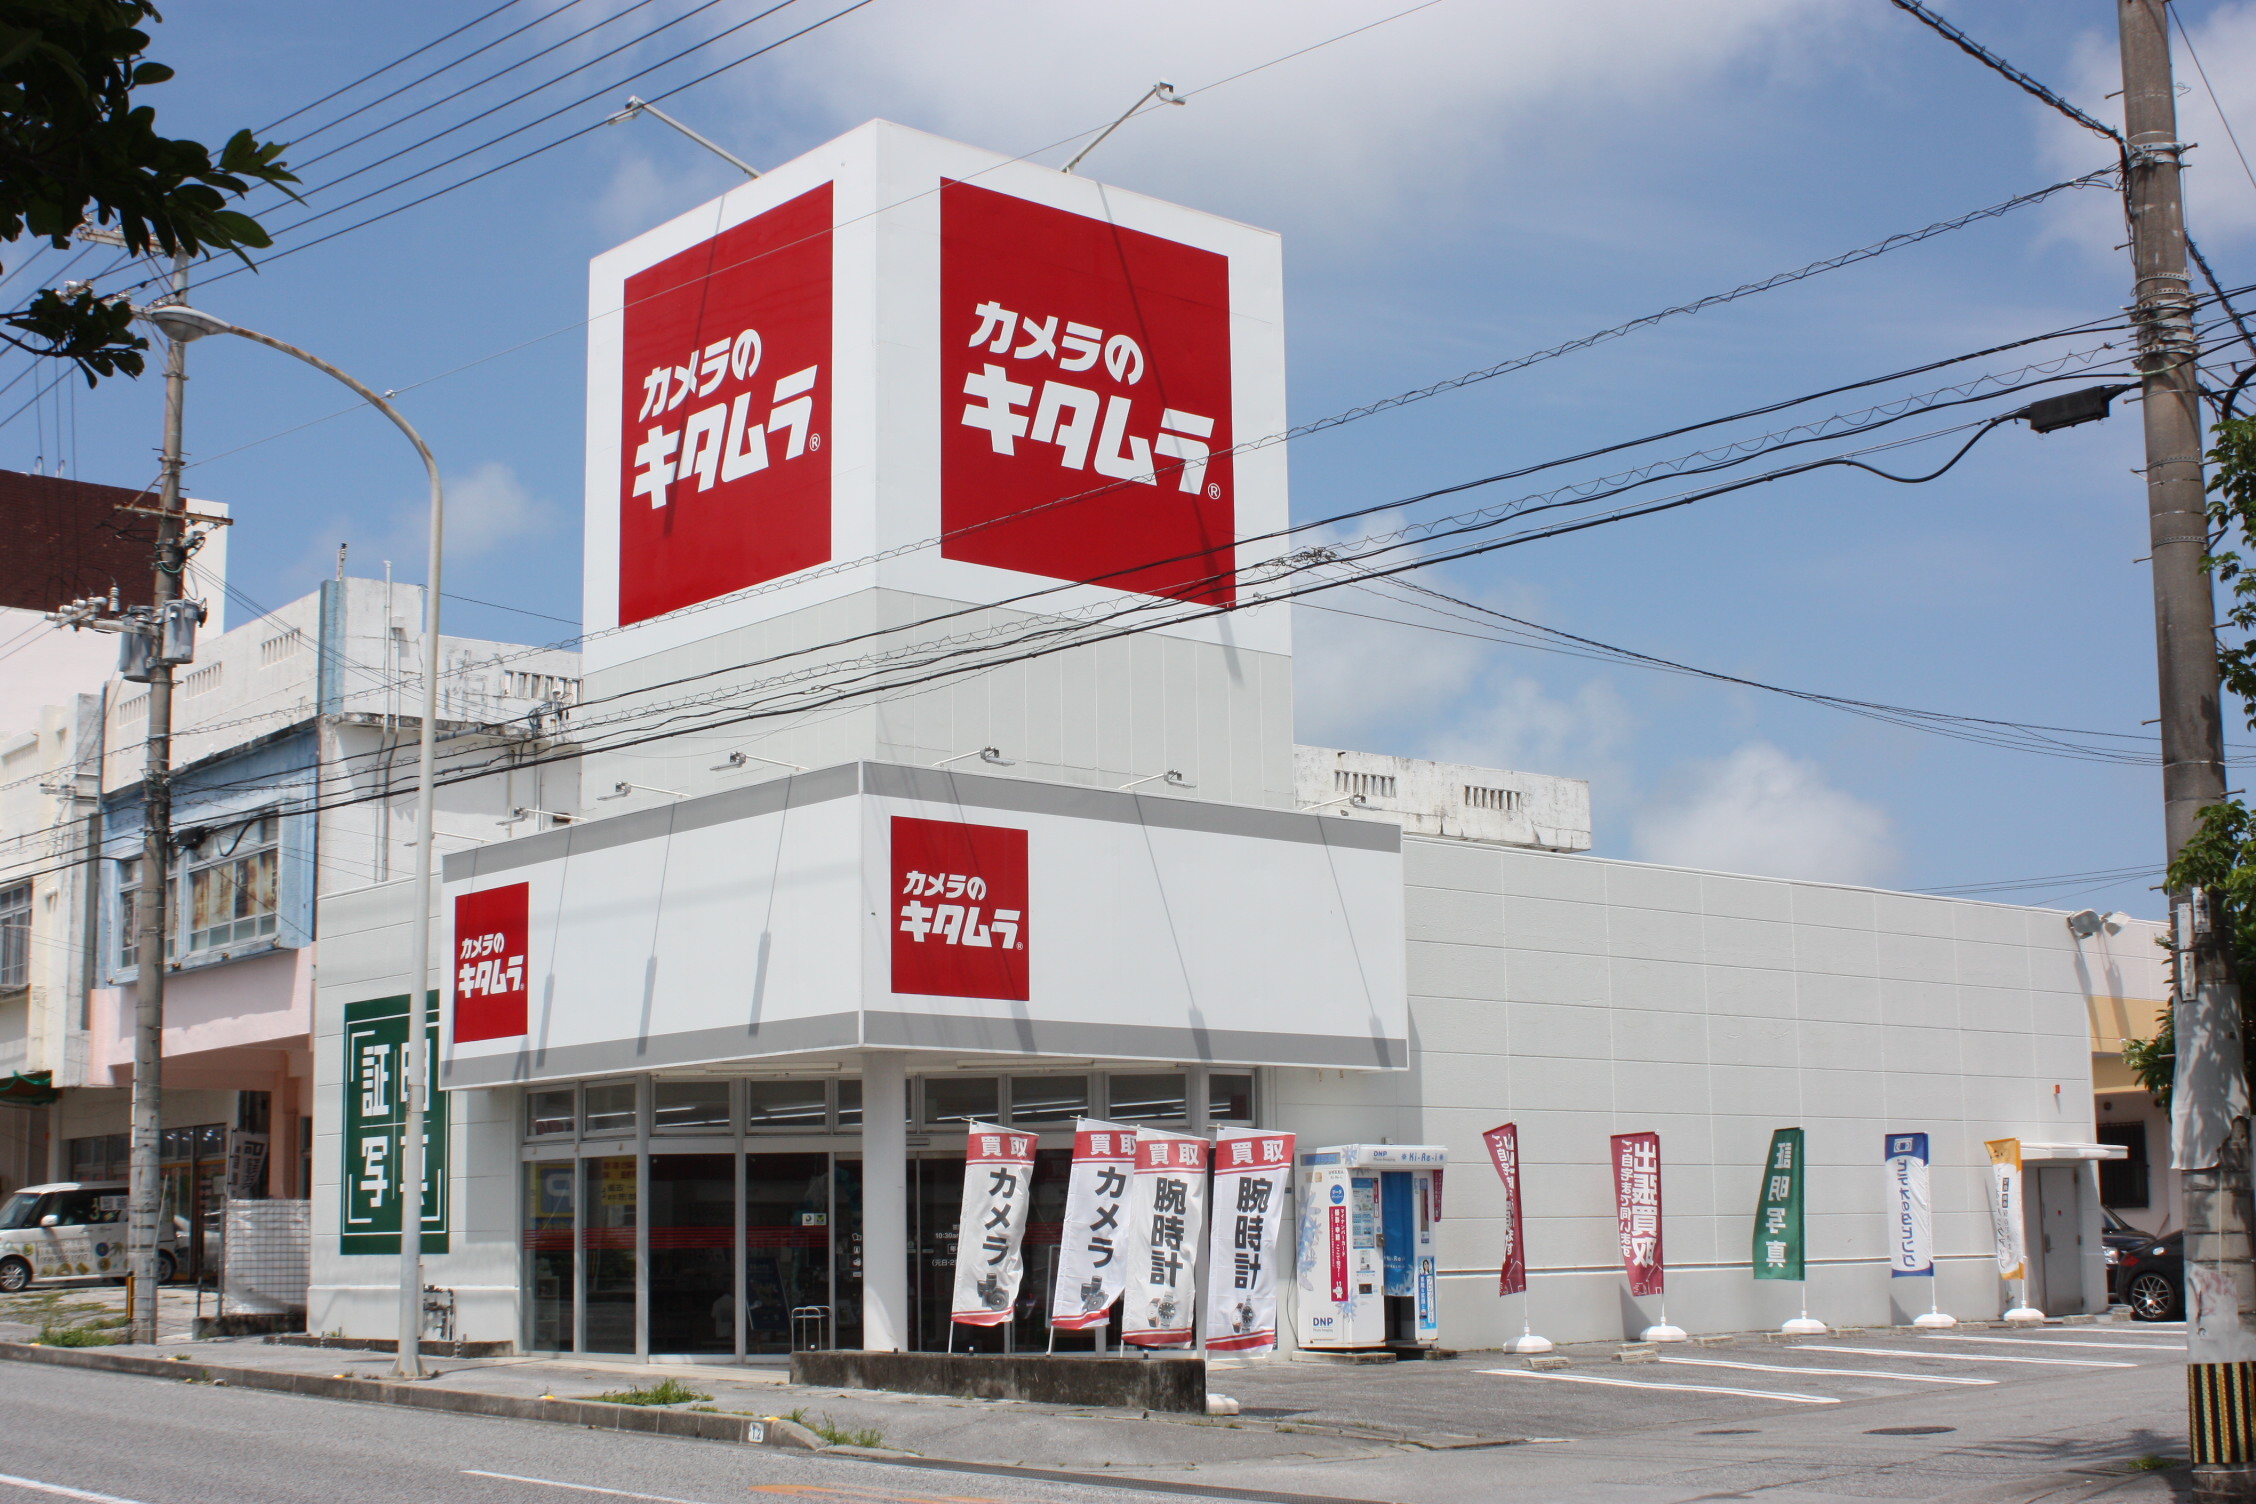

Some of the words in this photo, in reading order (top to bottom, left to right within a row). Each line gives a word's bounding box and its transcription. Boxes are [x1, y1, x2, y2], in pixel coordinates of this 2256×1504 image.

[969, 301, 1145, 387] カメラの
[638, 328, 763, 423] カメラの
[632, 364, 818, 510] キタムラ
[961, 362, 1215, 496] キタムラ
[902, 870, 987, 901] カメラの
[460, 932, 505, 960] カメラの
[899, 900, 1021, 950] キタムラ
[457, 954, 524, 999] キタムラ
[980, 1135, 1029, 1158] 買取
[1090, 1133, 1137, 1157] 買取
[1149, 1142, 1201, 1166] 買取
[1231, 1139, 1284, 1166] 買取
[982, 1167, 1017, 1267] カメラ
[1089, 1166, 1127, 1269] カメラ
[1150, 1177, 1187, 1288] 腕時計
[1235, 1176, 1273, 1290] 腕時計
[1313, 1317, 1334, 1327] DNP
